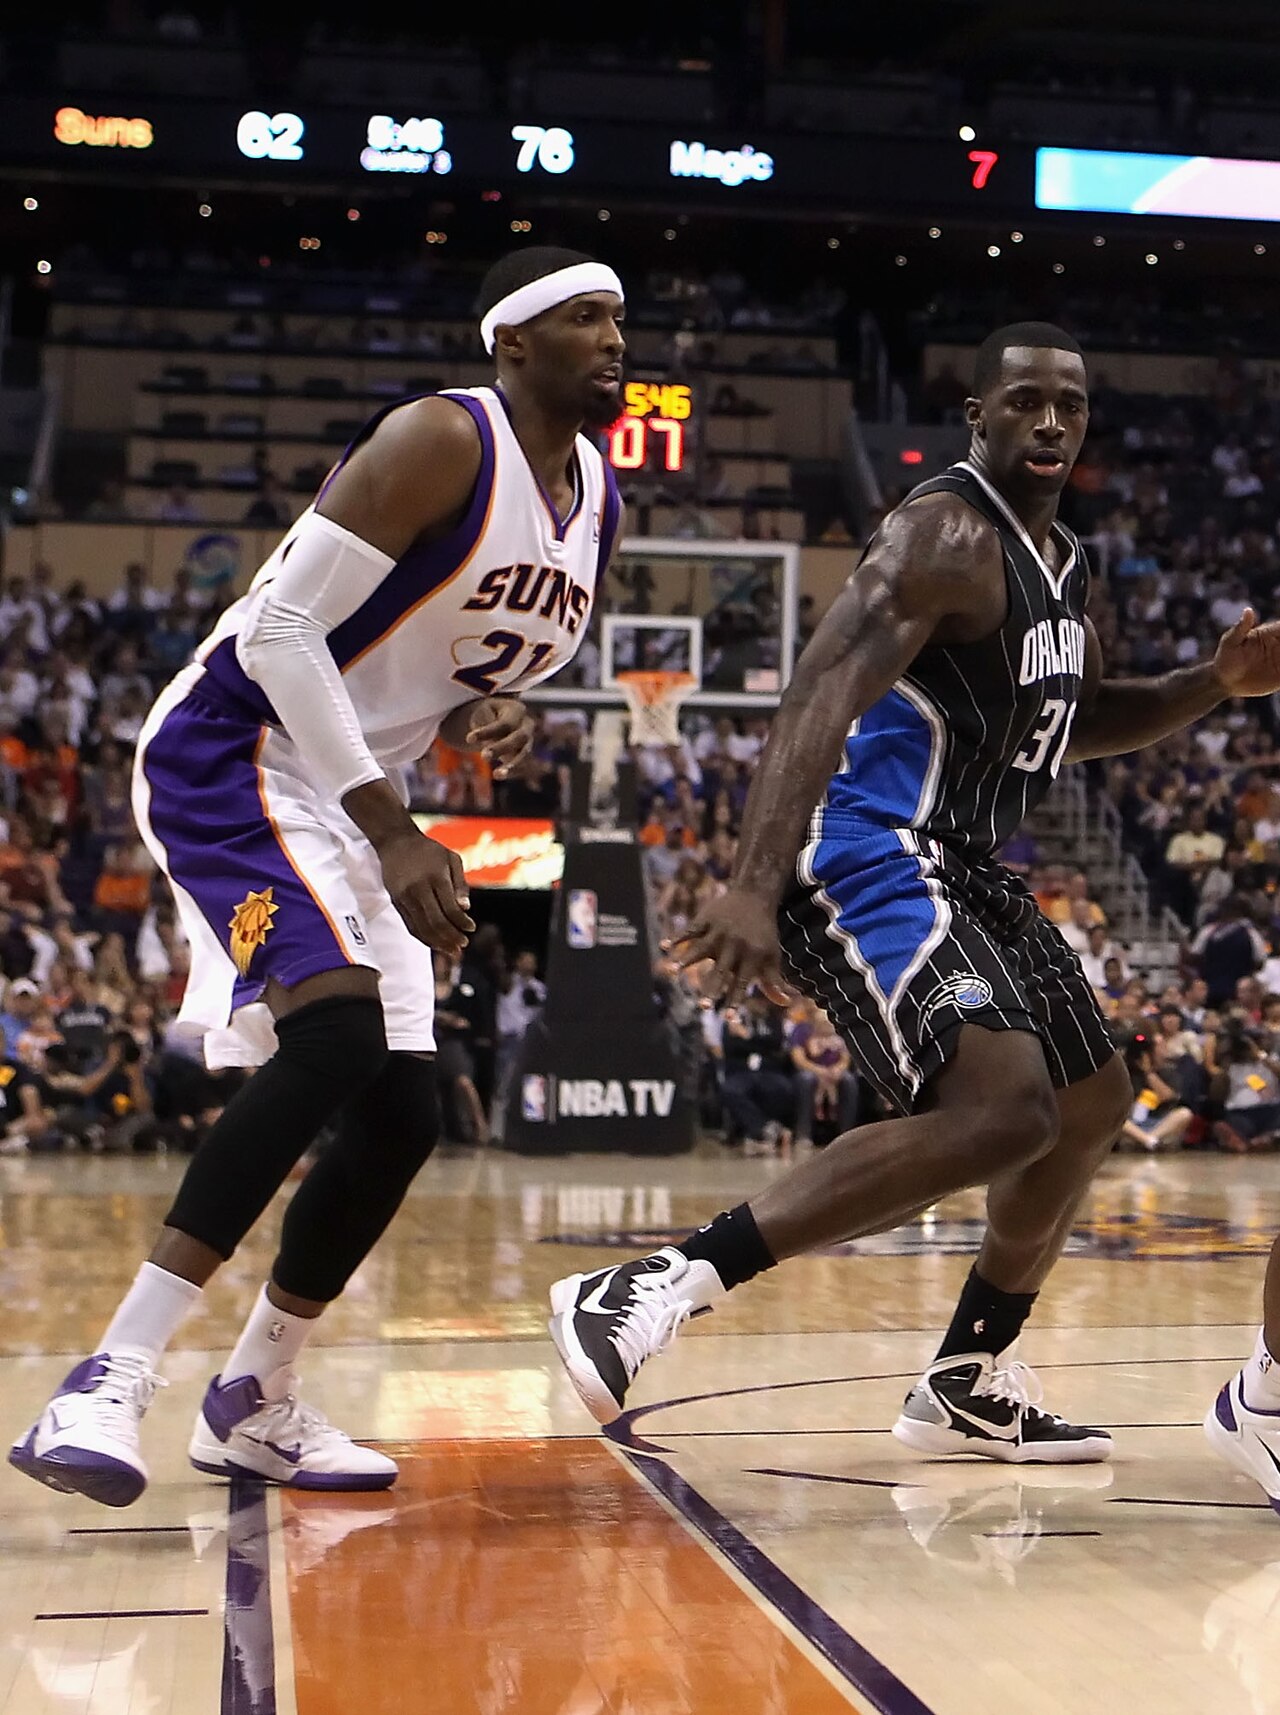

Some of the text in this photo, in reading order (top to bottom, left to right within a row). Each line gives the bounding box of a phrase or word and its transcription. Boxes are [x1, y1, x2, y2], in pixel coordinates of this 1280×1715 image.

[54, 107, 153, 148] Suns
[237, 111, 304, 160] 62
[512, 126, 574, 173] 76
[670, 141, 773, 186] Magic
[968, 151, 998, 188] 7
[609, 416, 684, 471] 07
[461, 563, 589, 634] SUNS
[451, 627, 556, 695] 21
[558, 1079, 676, 1117] NBA TV
